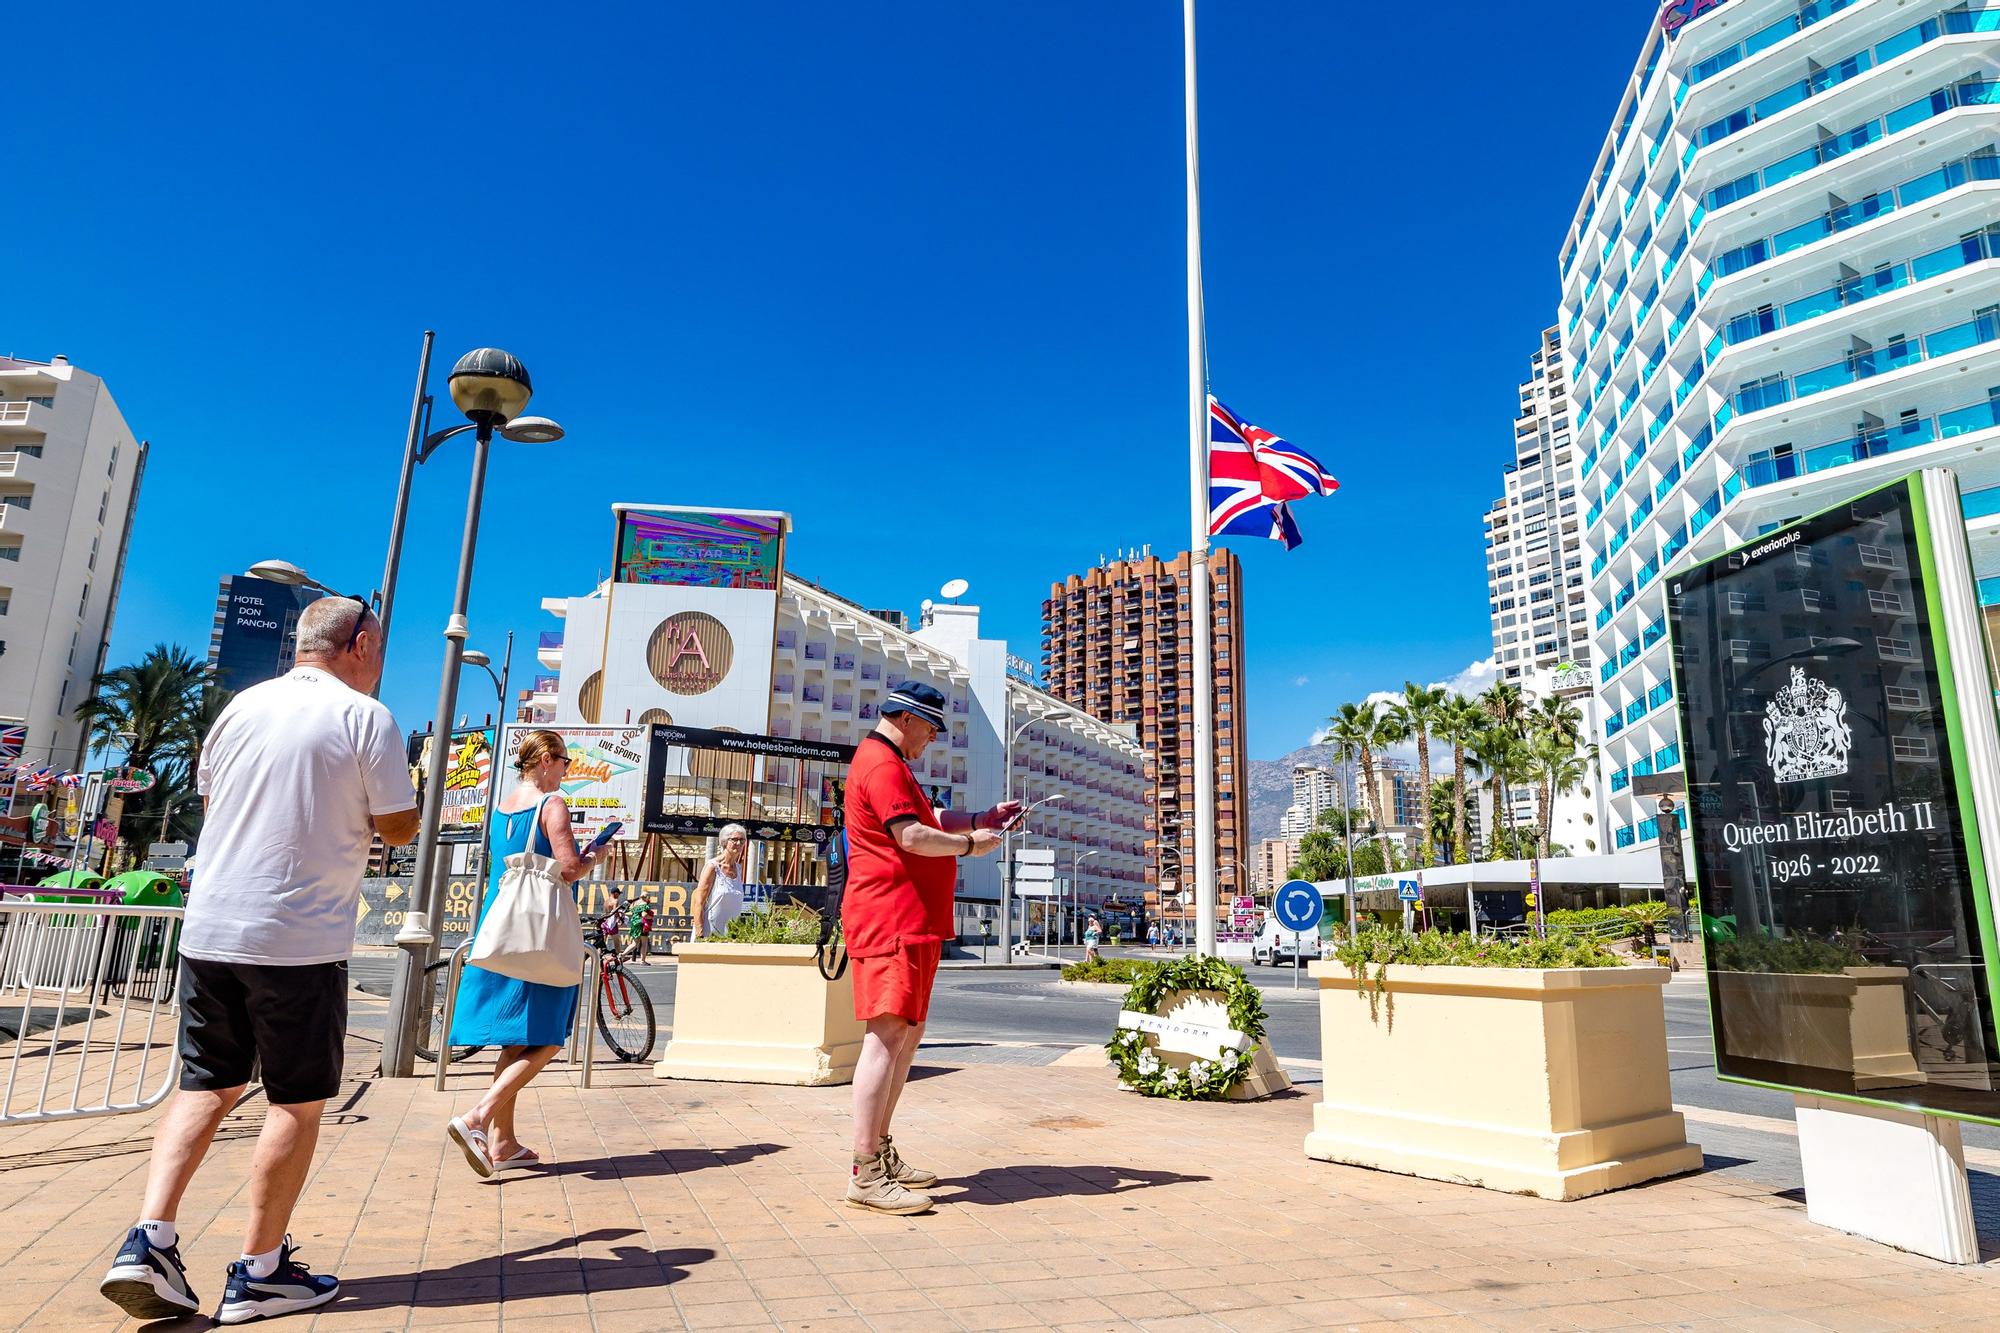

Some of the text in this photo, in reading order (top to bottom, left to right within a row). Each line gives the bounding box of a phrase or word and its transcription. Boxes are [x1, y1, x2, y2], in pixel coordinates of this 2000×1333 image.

[1751, 529, 1802, 561] exteriorplus
[688, 548, 723, 559] STAR
[233, 595, 265, 606] HOTEL
[239, 607, 262, 617] DON
[236, 618, 278, 629] PANCHO
[654, 729, 686, 739] BENIDORM
[508, 746, 520, 757] LIV
[598, 739, 642, 764] LIVE SPORTS
[722, 738, 840, 758] www.hotelesbenidorm.com
[1723, 801, 1936, 853] Queen Elizabeth II
[1770, 855, 1811, 883] 1926
[1831, 855, 1881, 876] 2022
[115, 1253, 137, 1265] PUMA
